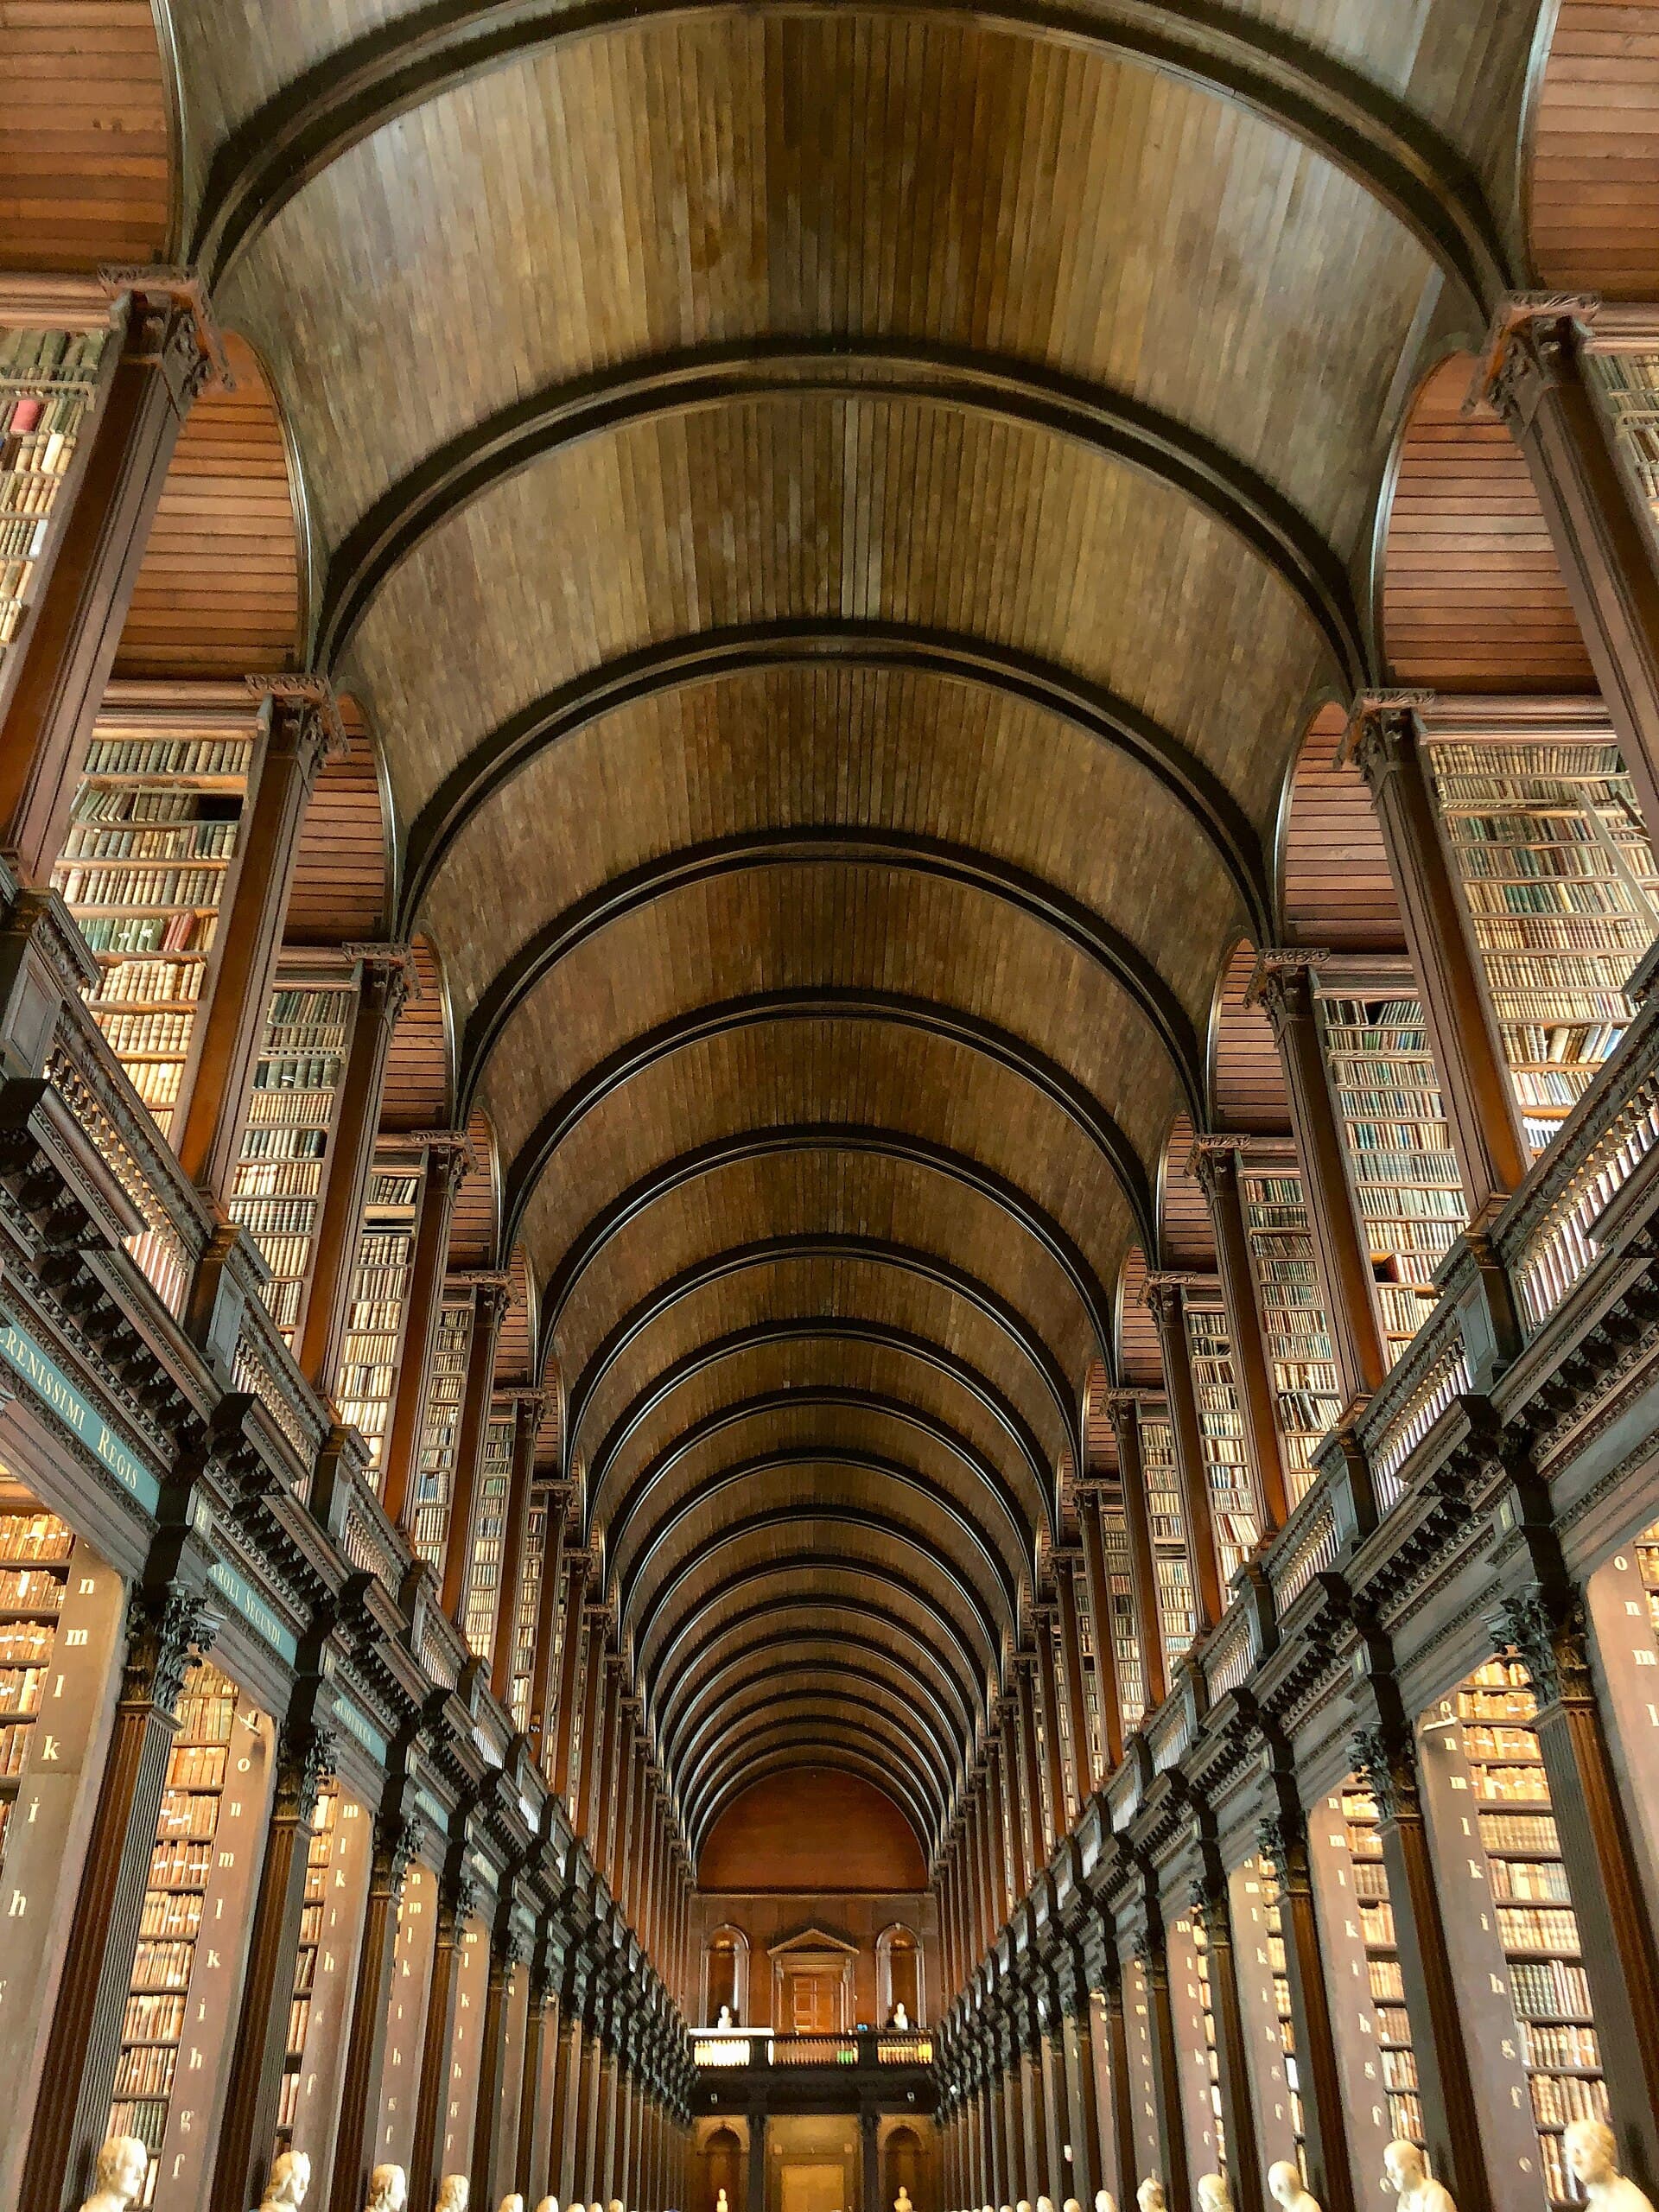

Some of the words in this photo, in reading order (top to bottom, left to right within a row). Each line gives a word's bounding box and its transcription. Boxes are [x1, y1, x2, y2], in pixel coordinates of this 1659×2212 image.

[0, 1327, 86, 1431] RENISSIMI
[97, 1425, 139, 1490] REGIS
[1613, 1555, 1629, 1571] o
[78, 1578, 95, 1594] n
[1624, 1601, 1643, 1616] n
[64, 1629, 89, 1646] m
[1630, 1649, 1658, 1666] m
[54, 1675, 64, 1697] l
[41, 1736, 60, 1760] k
[1443, 1737, 1459, 1751] n
[237, 1758, 251, 1772] o
[230, 1802, 242, 1817] n
[342, 1804, 359, 1819] m
[1328, 1834, 1347, 1847] m
[218, 1852, 235, 1868] m
[1466, 1859, 1484, 1879] k
[335, 1869, 346, 1888] k
[8, 1890, 26, 1916] h
[1344, 1920, 1359, 1938] k
[207, 1948, 221, 1968] k
[323, 1951, 335, 1973] h
[1488, 1973, 1507, 1995] h
[1357, 2012, 1372, 2034] h
[189, 2047, 203, 2069] h
[181, 2110, 195, 2133] g
[172, 2154, 185, 2178] f
